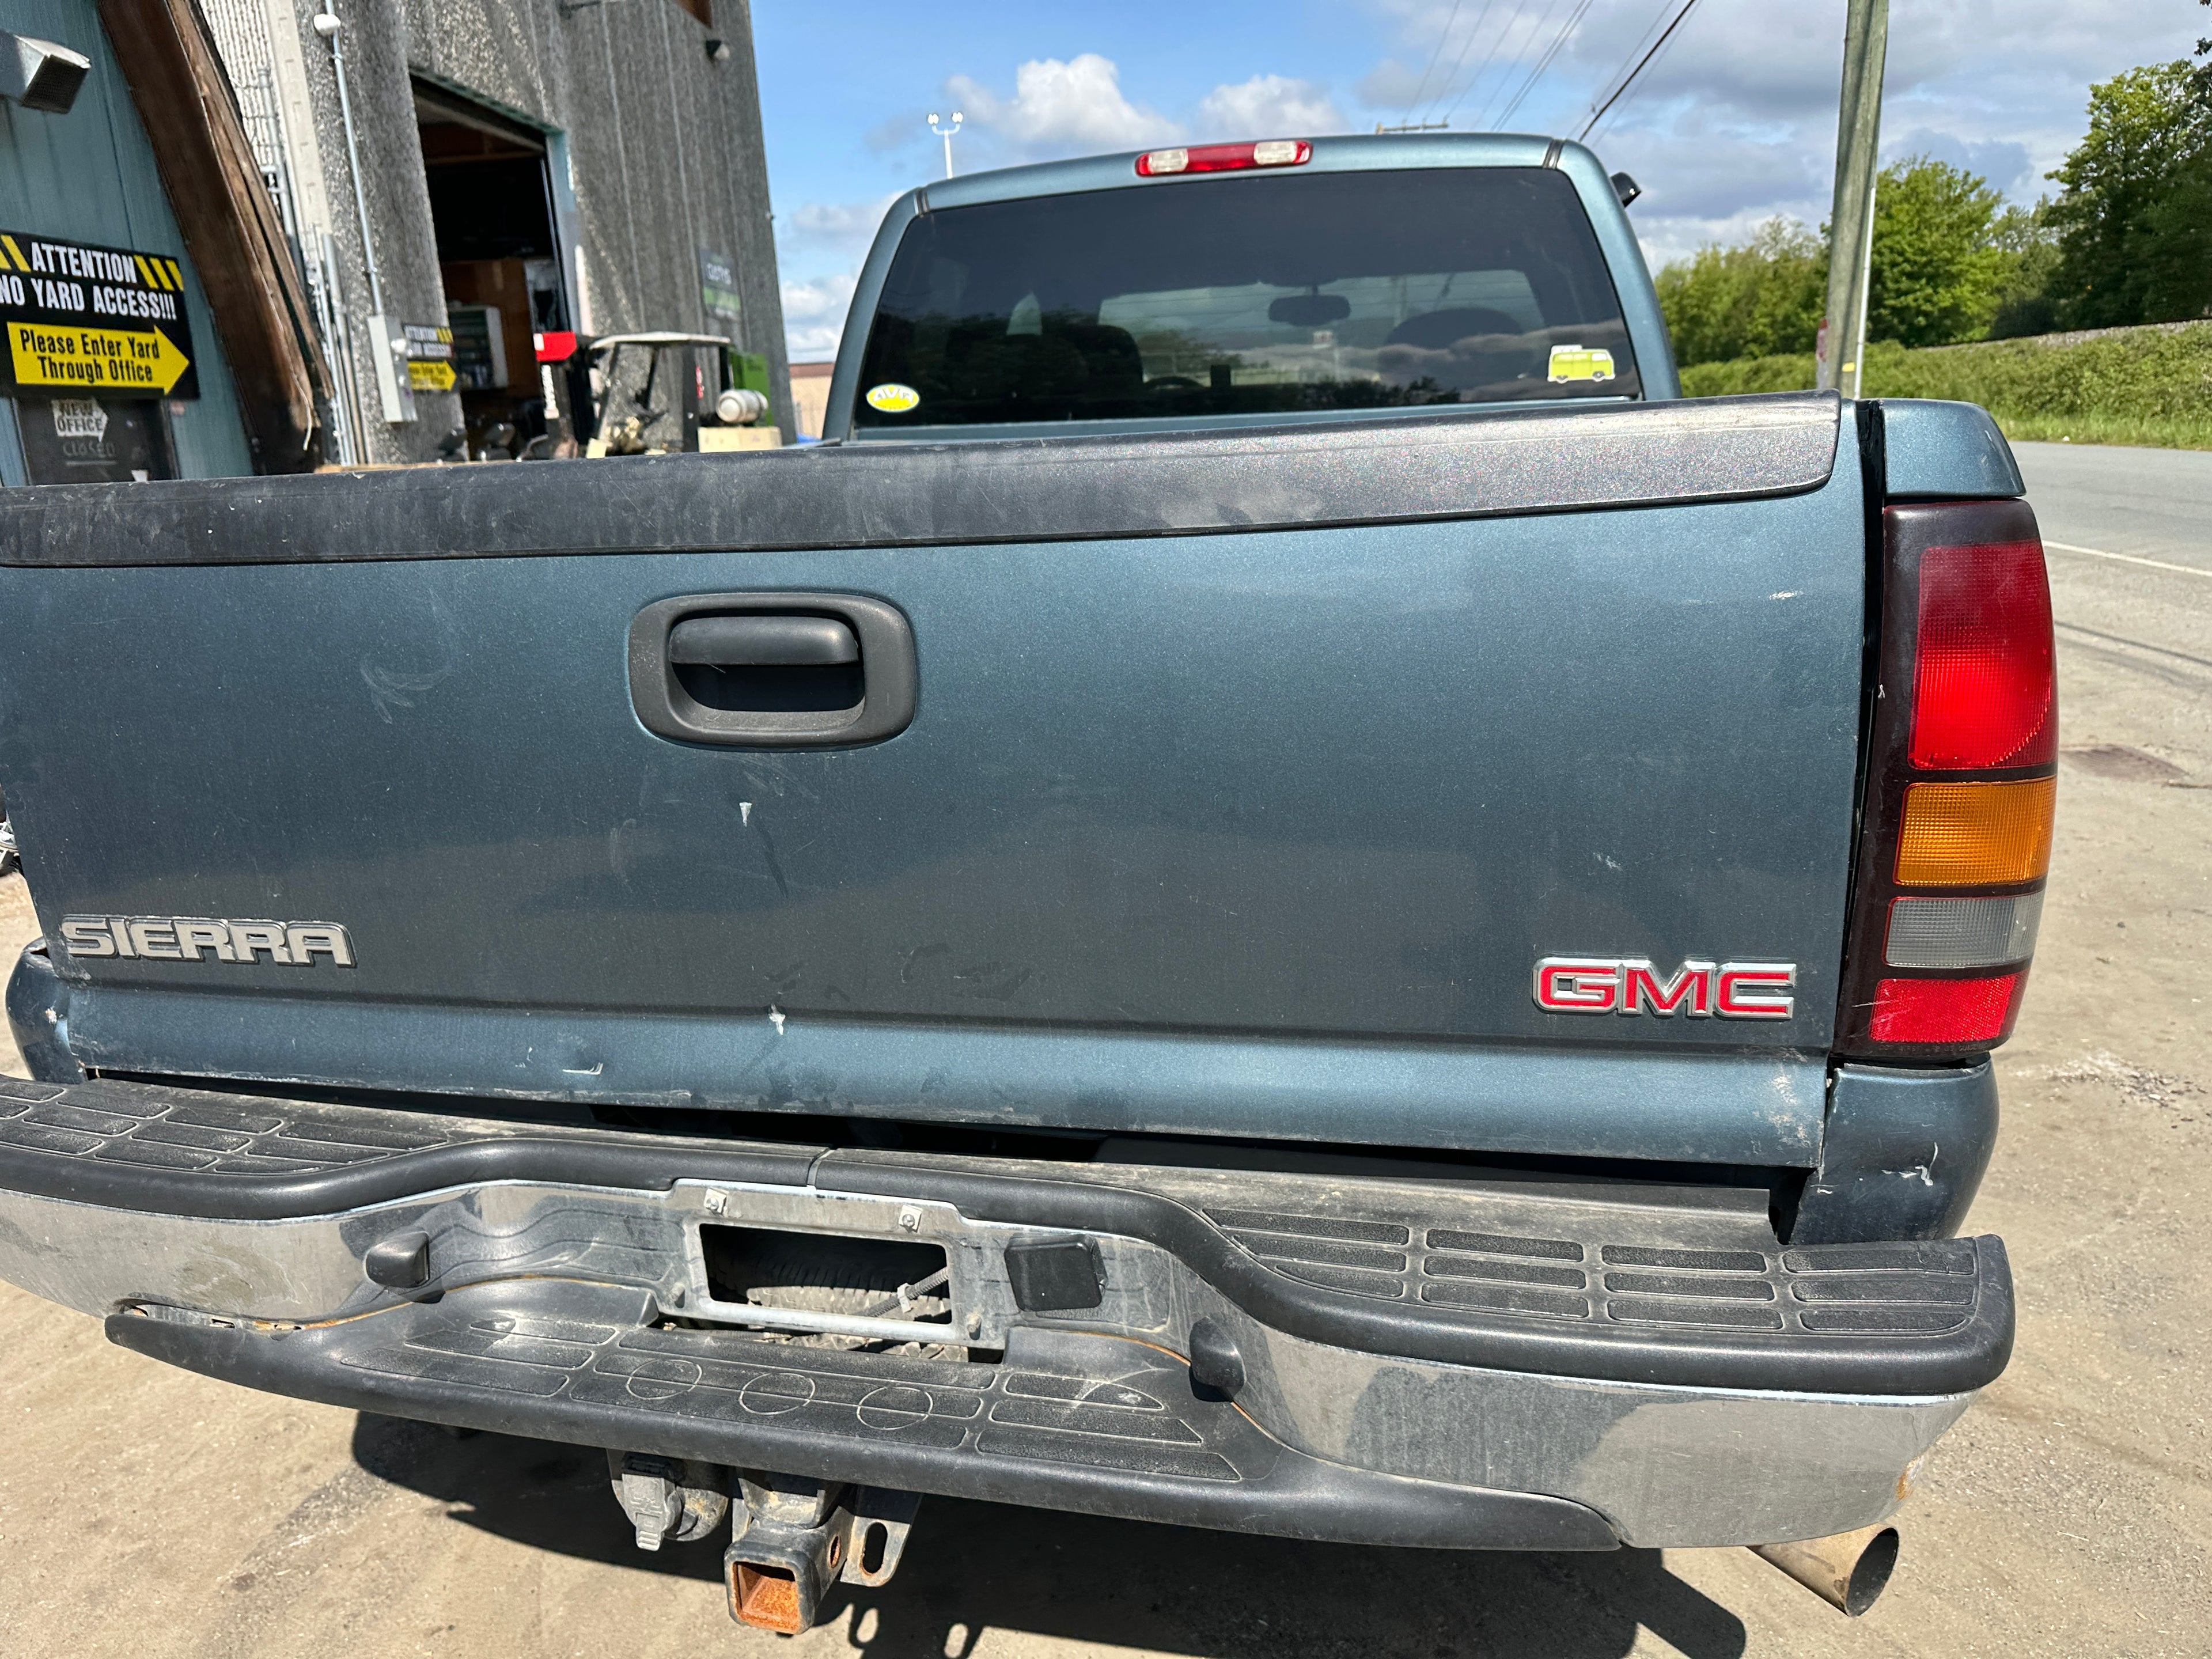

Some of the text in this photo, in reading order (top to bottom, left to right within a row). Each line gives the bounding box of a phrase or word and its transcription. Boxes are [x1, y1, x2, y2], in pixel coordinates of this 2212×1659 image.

[32, 242, 138, 284] ATTENTION
[0, 274, 177, 320] NO YARD ACCESS!!!
[20, 329, 160, 359] Please Enter Yard
[37, 356, 153, 383] Through Office
[58, 416, 104, 432] OFFICE
[62, 914, 357, 968] SIERRA
[1532, 956, 1797, 1020] GMC
